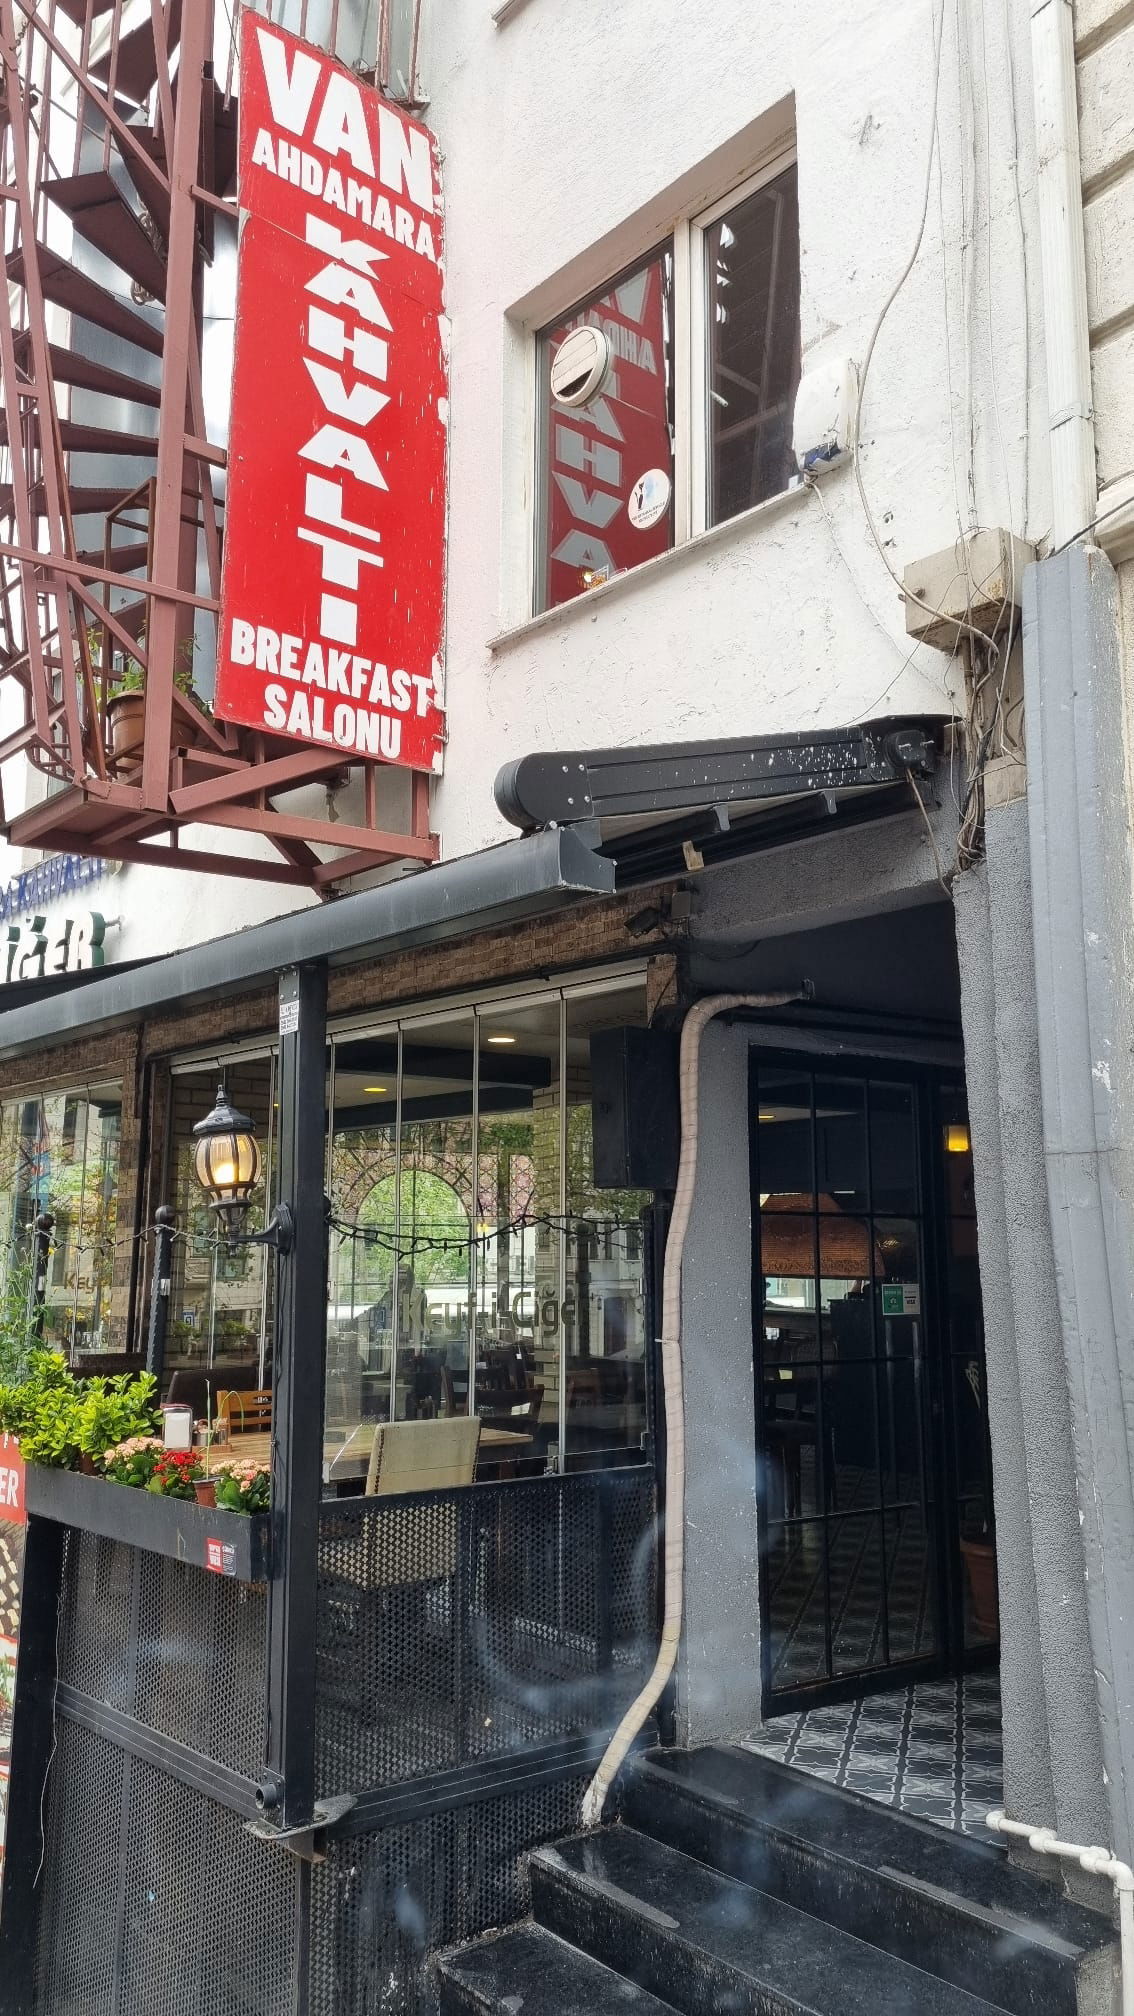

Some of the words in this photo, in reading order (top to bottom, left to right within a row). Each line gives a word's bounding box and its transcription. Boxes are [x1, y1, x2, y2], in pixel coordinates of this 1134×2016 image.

[256, 26, 433, 214] VAN
[252, 127, 436, 263] AHDAMARA
[297, 213, 393, 647] KAHVALTI
[231, 618, 433, 718] BREAKFAST
[263, 684, 401, 759] SALONU
[402, 1289, 581, 1337] Keyf-i-Ciğe
